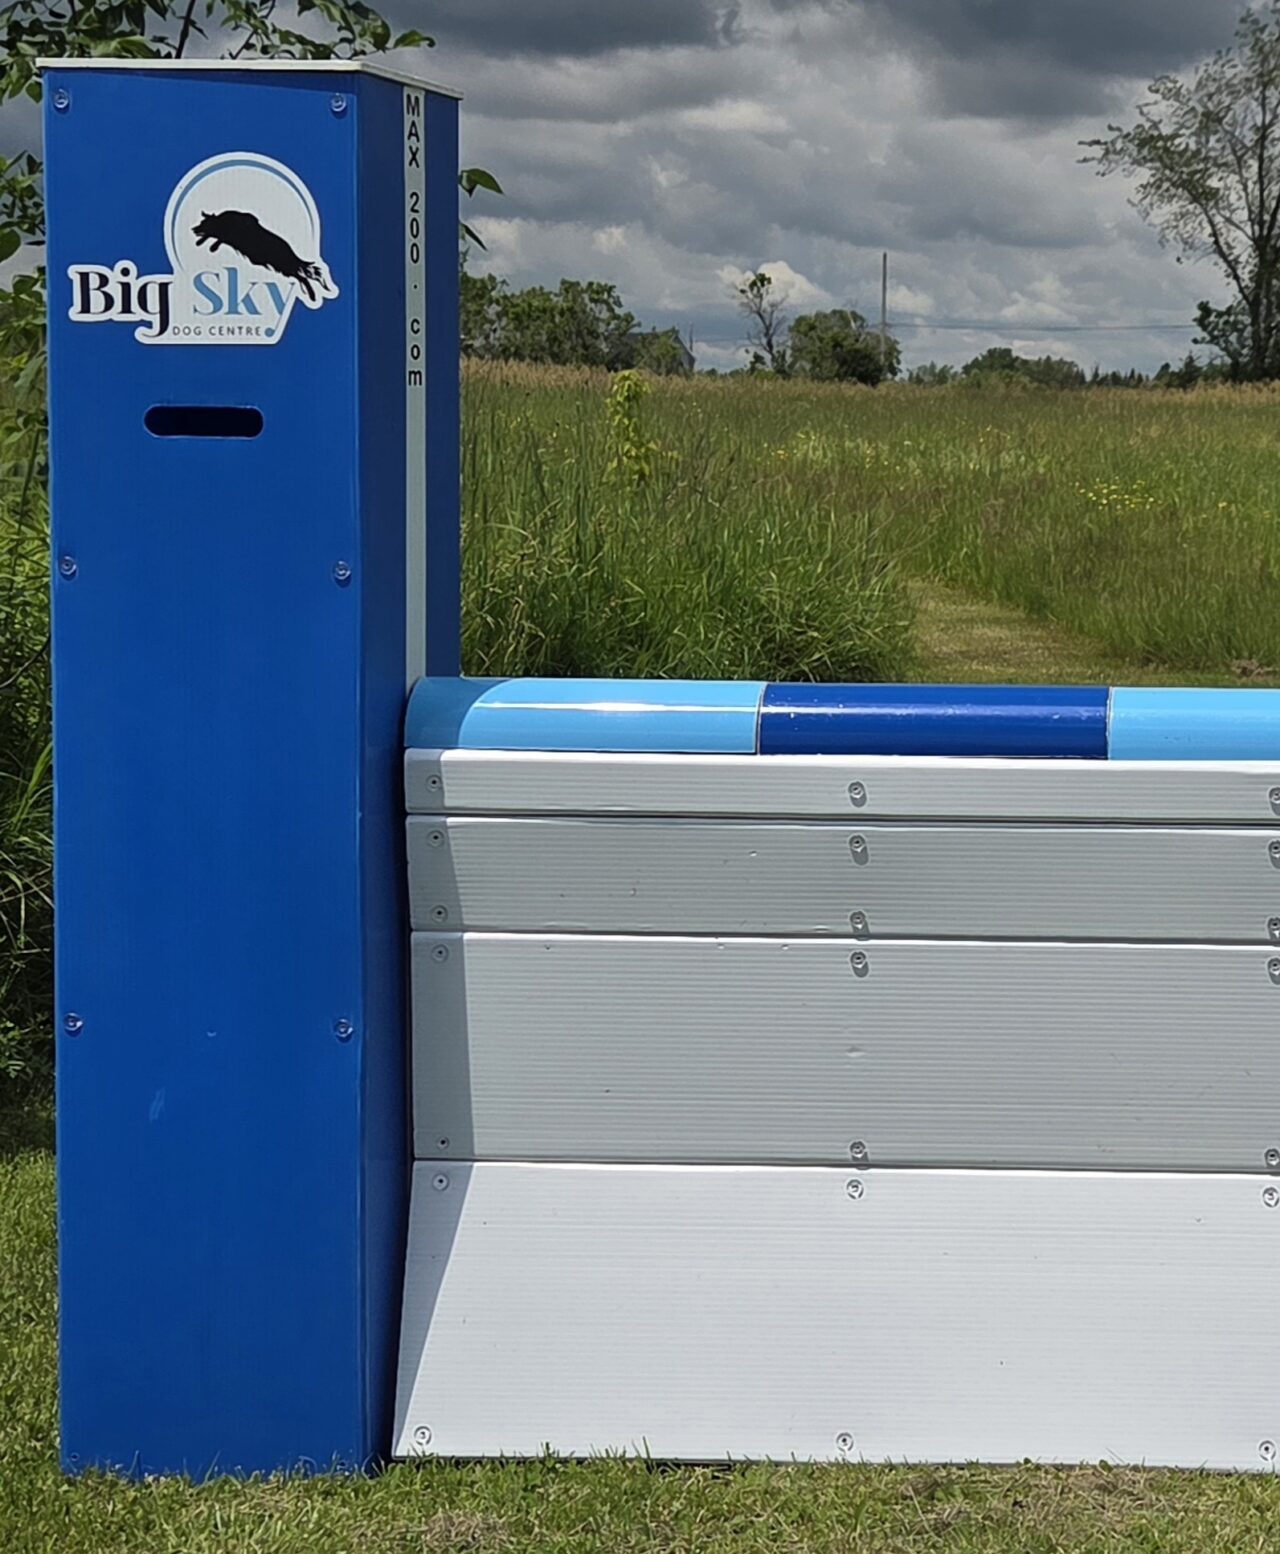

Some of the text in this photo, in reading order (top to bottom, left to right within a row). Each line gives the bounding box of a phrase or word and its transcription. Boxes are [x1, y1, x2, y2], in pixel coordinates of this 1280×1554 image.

[75, 266, 296, 338] Big Sky
[172, 325, 262, 337] DOG CENTRE
